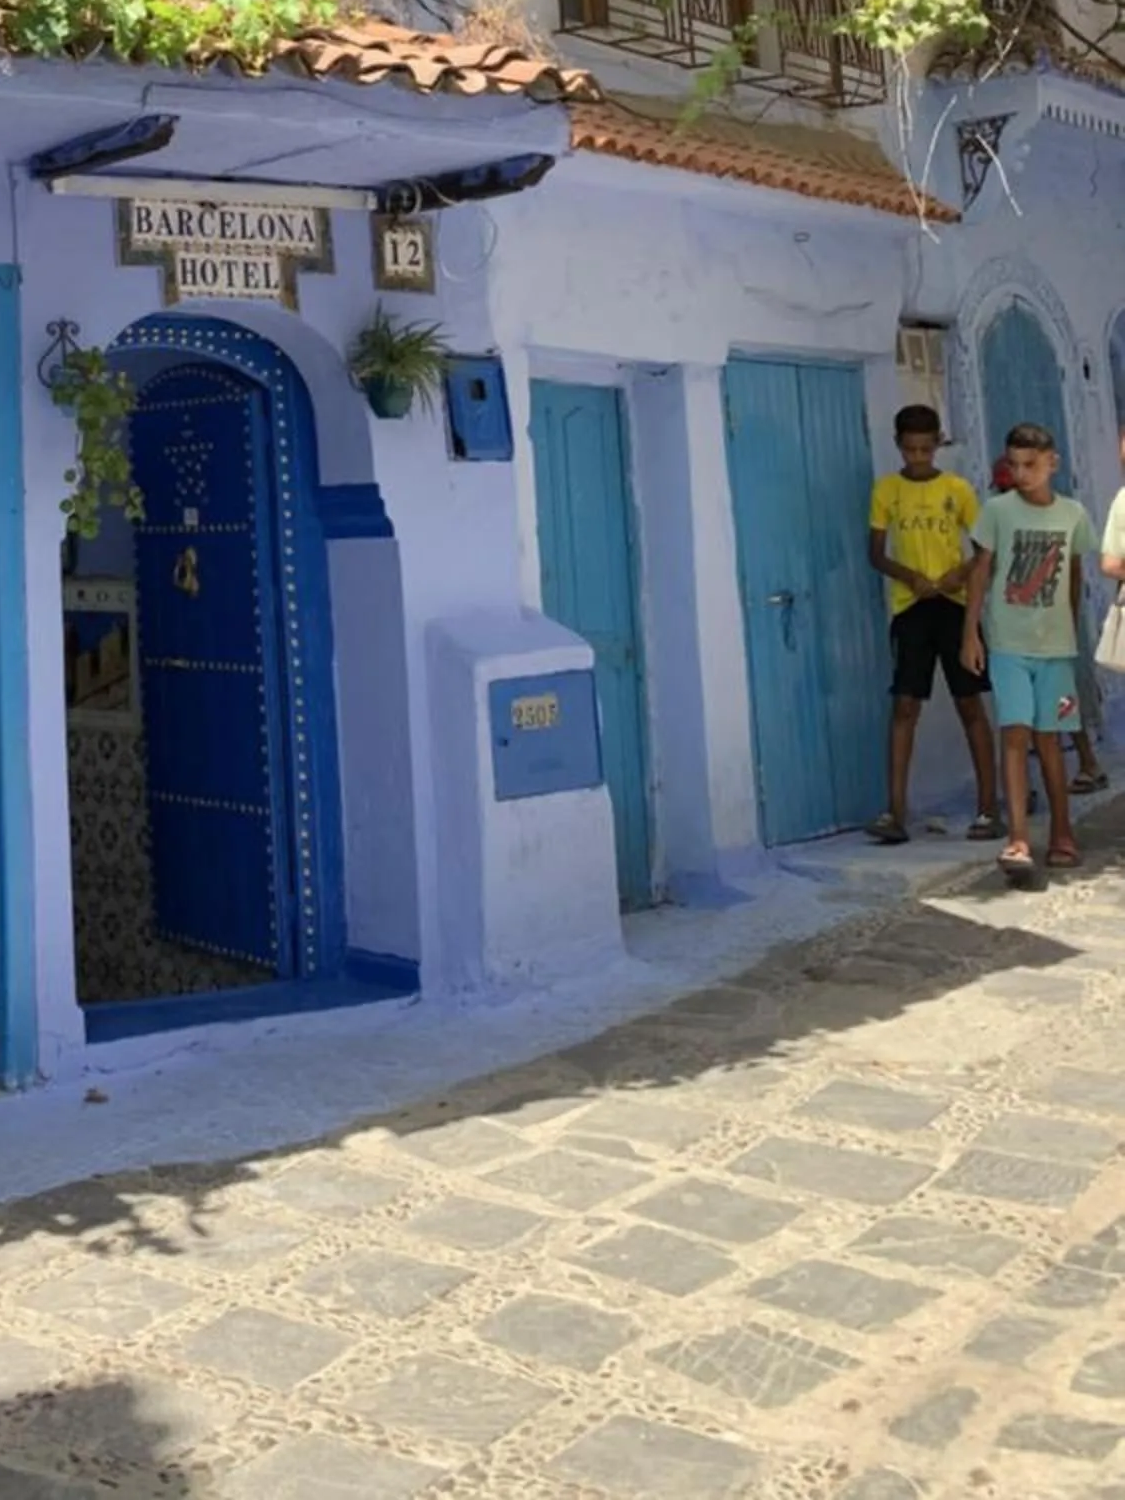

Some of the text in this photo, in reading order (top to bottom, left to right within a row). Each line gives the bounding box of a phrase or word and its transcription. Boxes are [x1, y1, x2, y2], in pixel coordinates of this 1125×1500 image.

[135, 206, 315, 243] BARCELONA
[391, 239, 421, 267] 12
[180, 258, 280, 290] HOTEL
